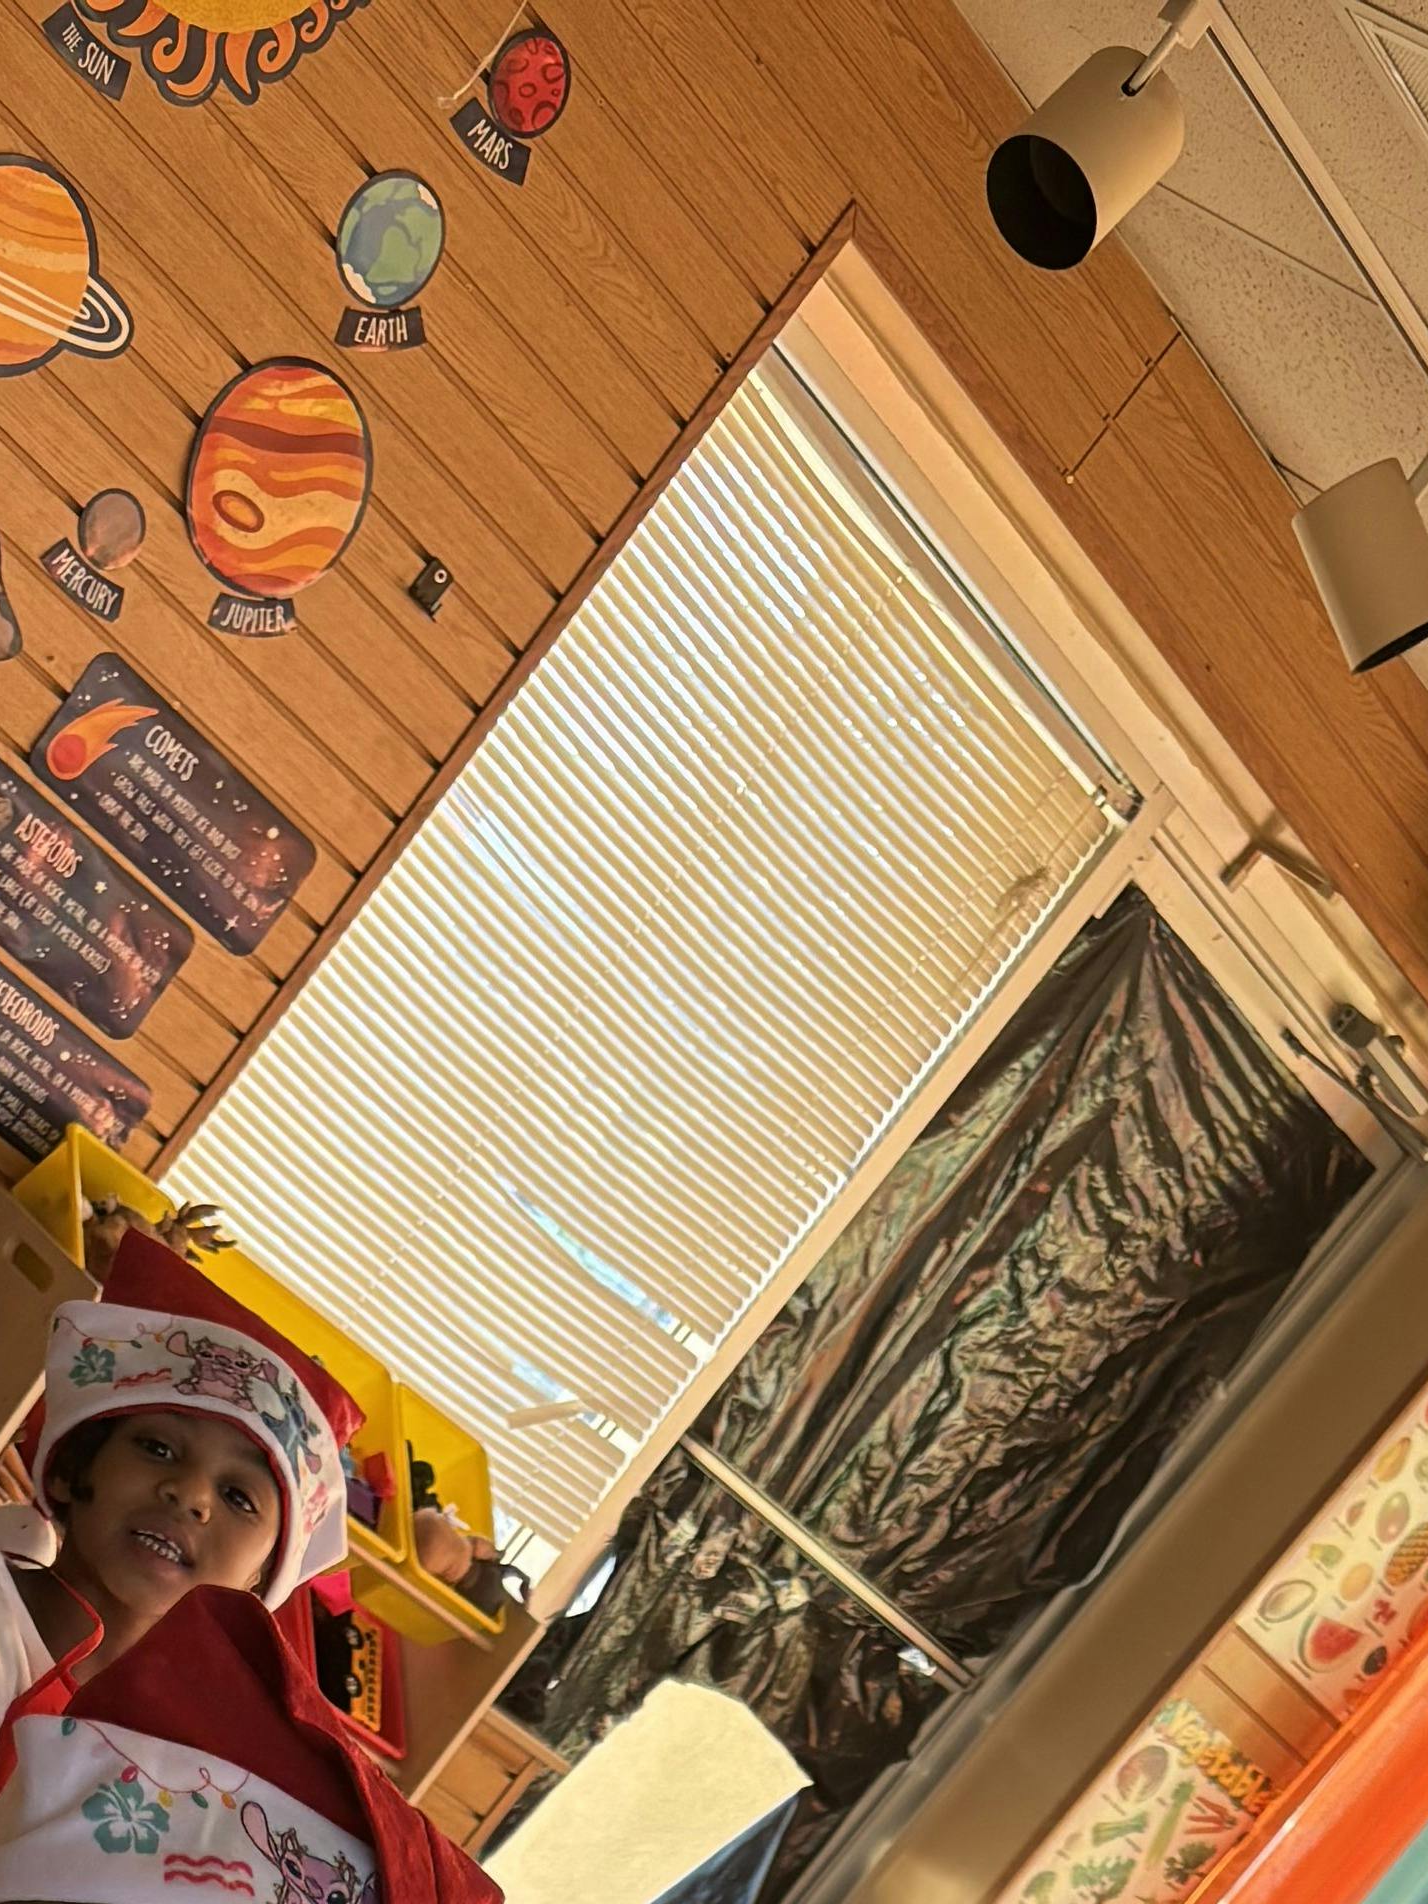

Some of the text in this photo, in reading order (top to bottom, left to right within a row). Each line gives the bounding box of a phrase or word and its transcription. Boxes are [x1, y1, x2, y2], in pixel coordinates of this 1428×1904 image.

[62, 22, 117, 86] THE SUN
[467, 118, 513, 170] MARS
[354, 315, 408, 346] EARTH
[52, 548, 119, 616] MERCURY
[220, 602, 289, 633] JUPITER
[144, 722, 200, 782] COMETS
[14, 812, 83, 880] ASTEROIDS
[1168, 1706, 1275, 1815] Vegetable
